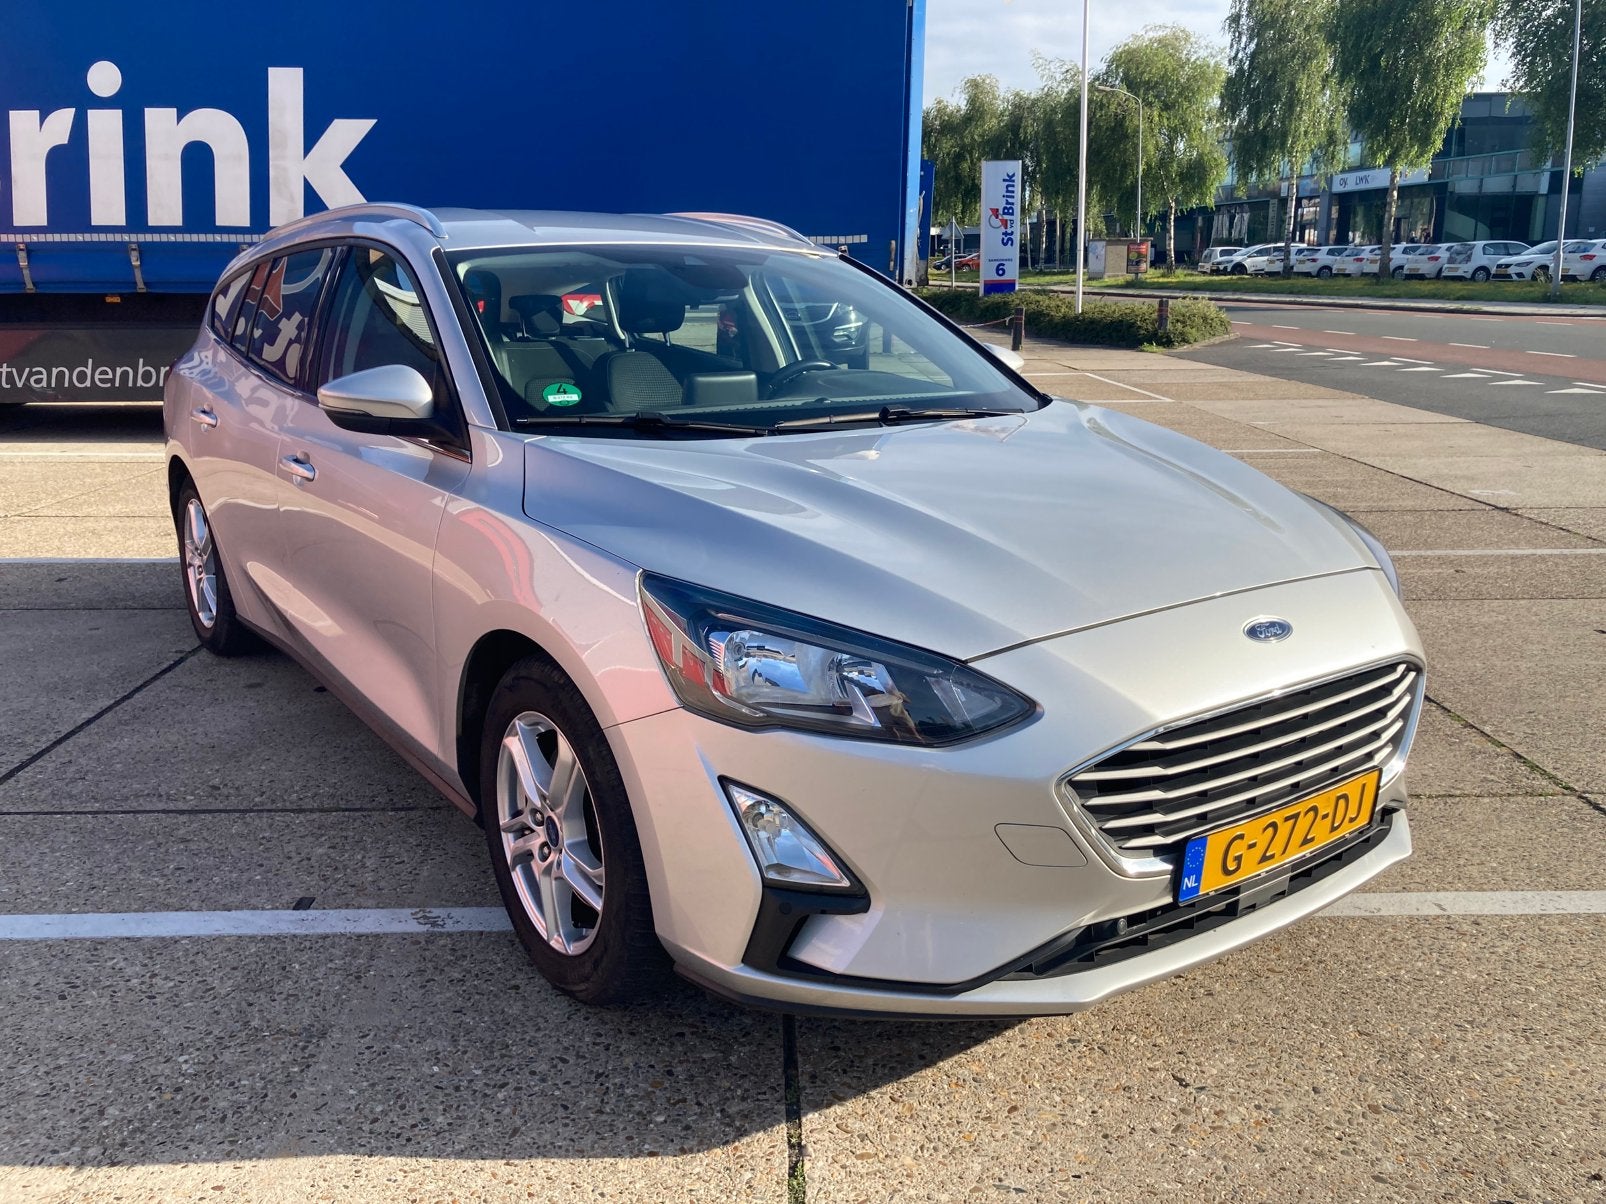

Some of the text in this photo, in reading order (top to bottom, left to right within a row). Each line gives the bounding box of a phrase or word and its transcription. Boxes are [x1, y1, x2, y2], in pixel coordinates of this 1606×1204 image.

[1002, 172, 1016, 216] Brink
[1001, 230, 1014, 247] St
[995, 262, 1006, 277] 6
[557, 384, 567, 394] 4
[1254, 622, 1284, 638] Ford
[1220, 781, 1367, 877] G-272-DJ
[1182, 874, 1199, 890] NL
